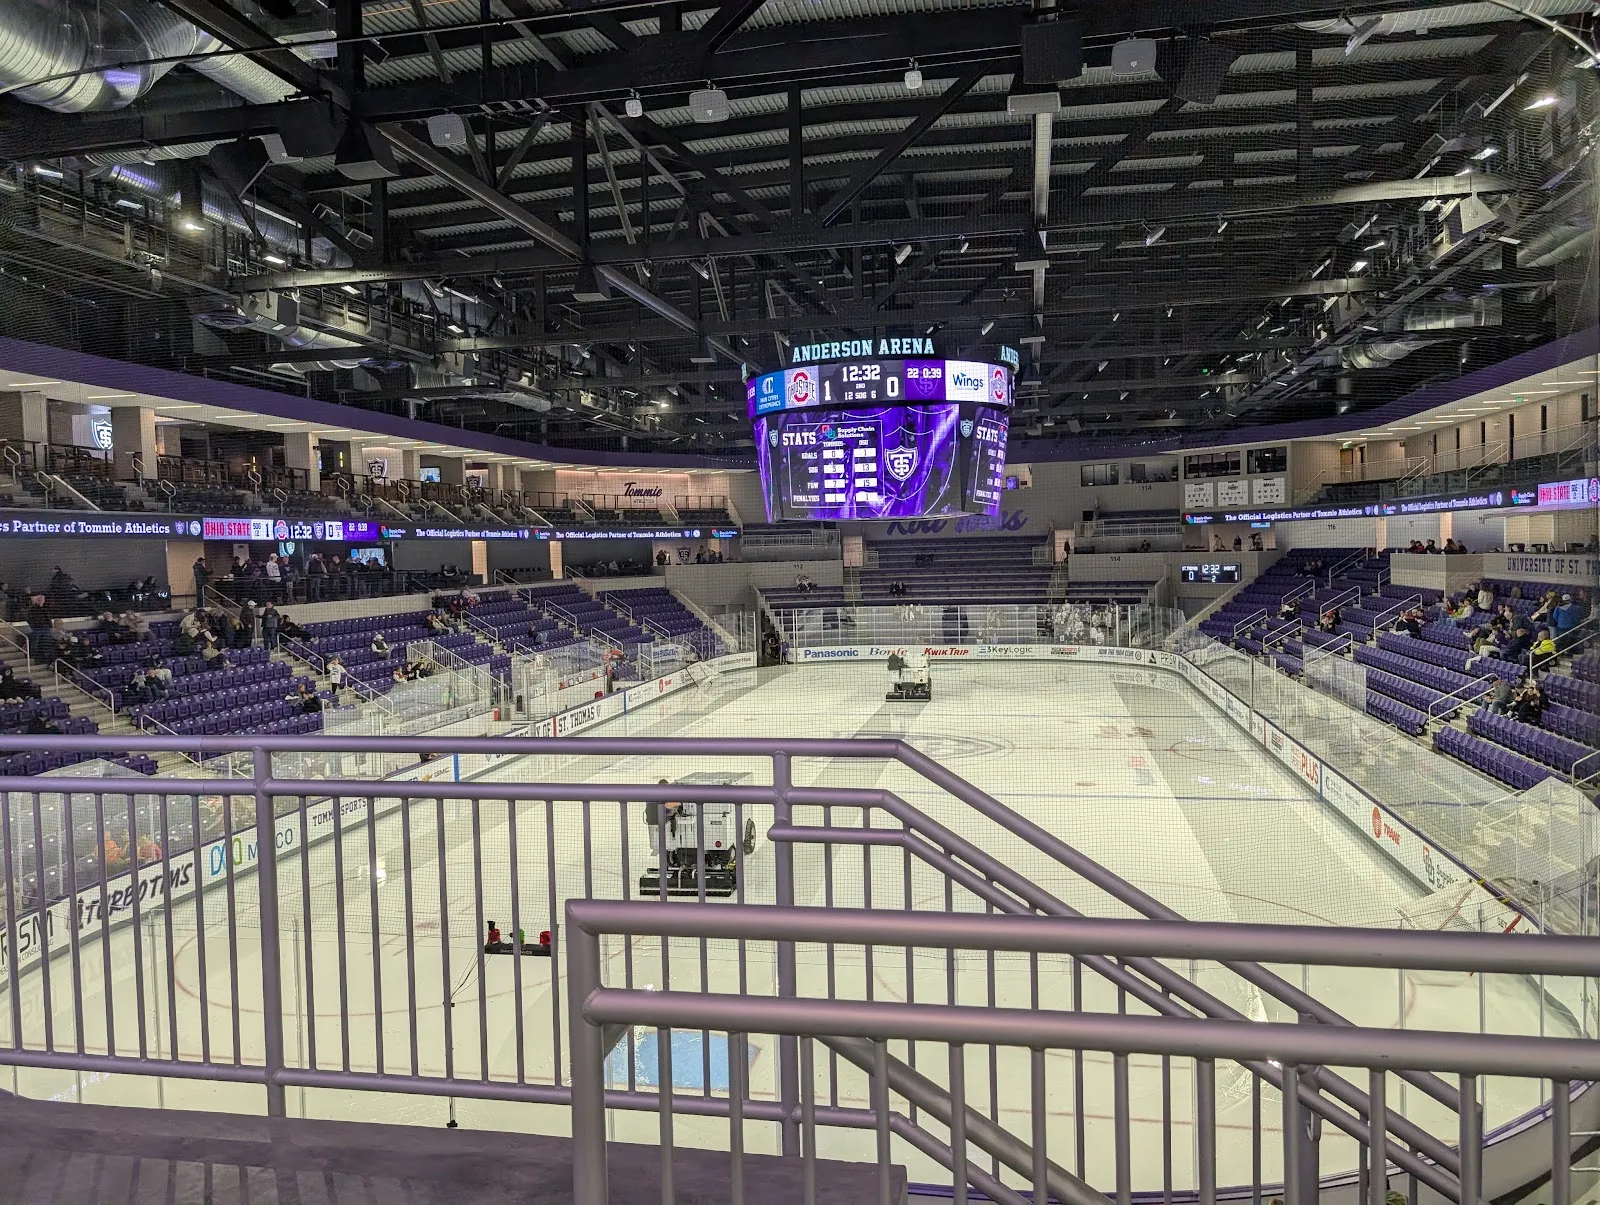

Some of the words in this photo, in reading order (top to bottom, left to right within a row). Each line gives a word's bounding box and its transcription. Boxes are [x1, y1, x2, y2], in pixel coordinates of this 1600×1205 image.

[792, 340, 872, 362] ANDERSON
[878, 338, 934, 355] ARENA
[842, 364, 880, 382] 12:32
[907, 368, 918, 378] 22
[922, 368, 942, 378] 0:39
[886, 376, 899, 397] 0
[952, 372, 984, 390] Wings
[824, 381, 832, 401] 1
[844, 392, 853, 400] 12
[871, 390, 876, 398] 6
[782, 432, 816, 446] STATS
[976, 426, 998, 442] STATS
[624, 482, 662, 497] Tommie
[1540, 488, 1552, 502] OHIO
[1554, 486, 1569, 500] STATE
[1469, 497, 1487, 506] Athletics
[13, 520, 60, 533] Partner
[64, 521, 76, 533] of
[78, 522, 122, 533] Tommie
[125, 522, 170, 534] Athletics
[205, 522, 224, 536] OHIO
[228, 522, 250, 536] STATE
[265, 523, 269, 537] 1
[290, 525, 312, 539] 12:32
[329, 524, 333, 538] 0
[444, 529, 464, 538] Logistics
[1202, 564, 1220, 574] 12:32
[1508, 557, 1552, 572] UNIVERSITY
[1555, 559, 1564, 574] OF
[1568, 560, 1581, 574] ST.
[1189, 572, 1194, 580] 0
[804, 649, 859, 658] Panasonic
[924, 647, 947, 656] KWIK
[949, 648, 969, 656] TRIP
[987, 646, 1032, 654] 3KeyLogic
[559, 717, 568, 733] ST.
[570, 707, 594, 728] THOMAS
[434, 766, 449, 777] GMC
[1302, 753, 1318, 785] PLUS
[1384, 823, 1400, 845] TRANE
